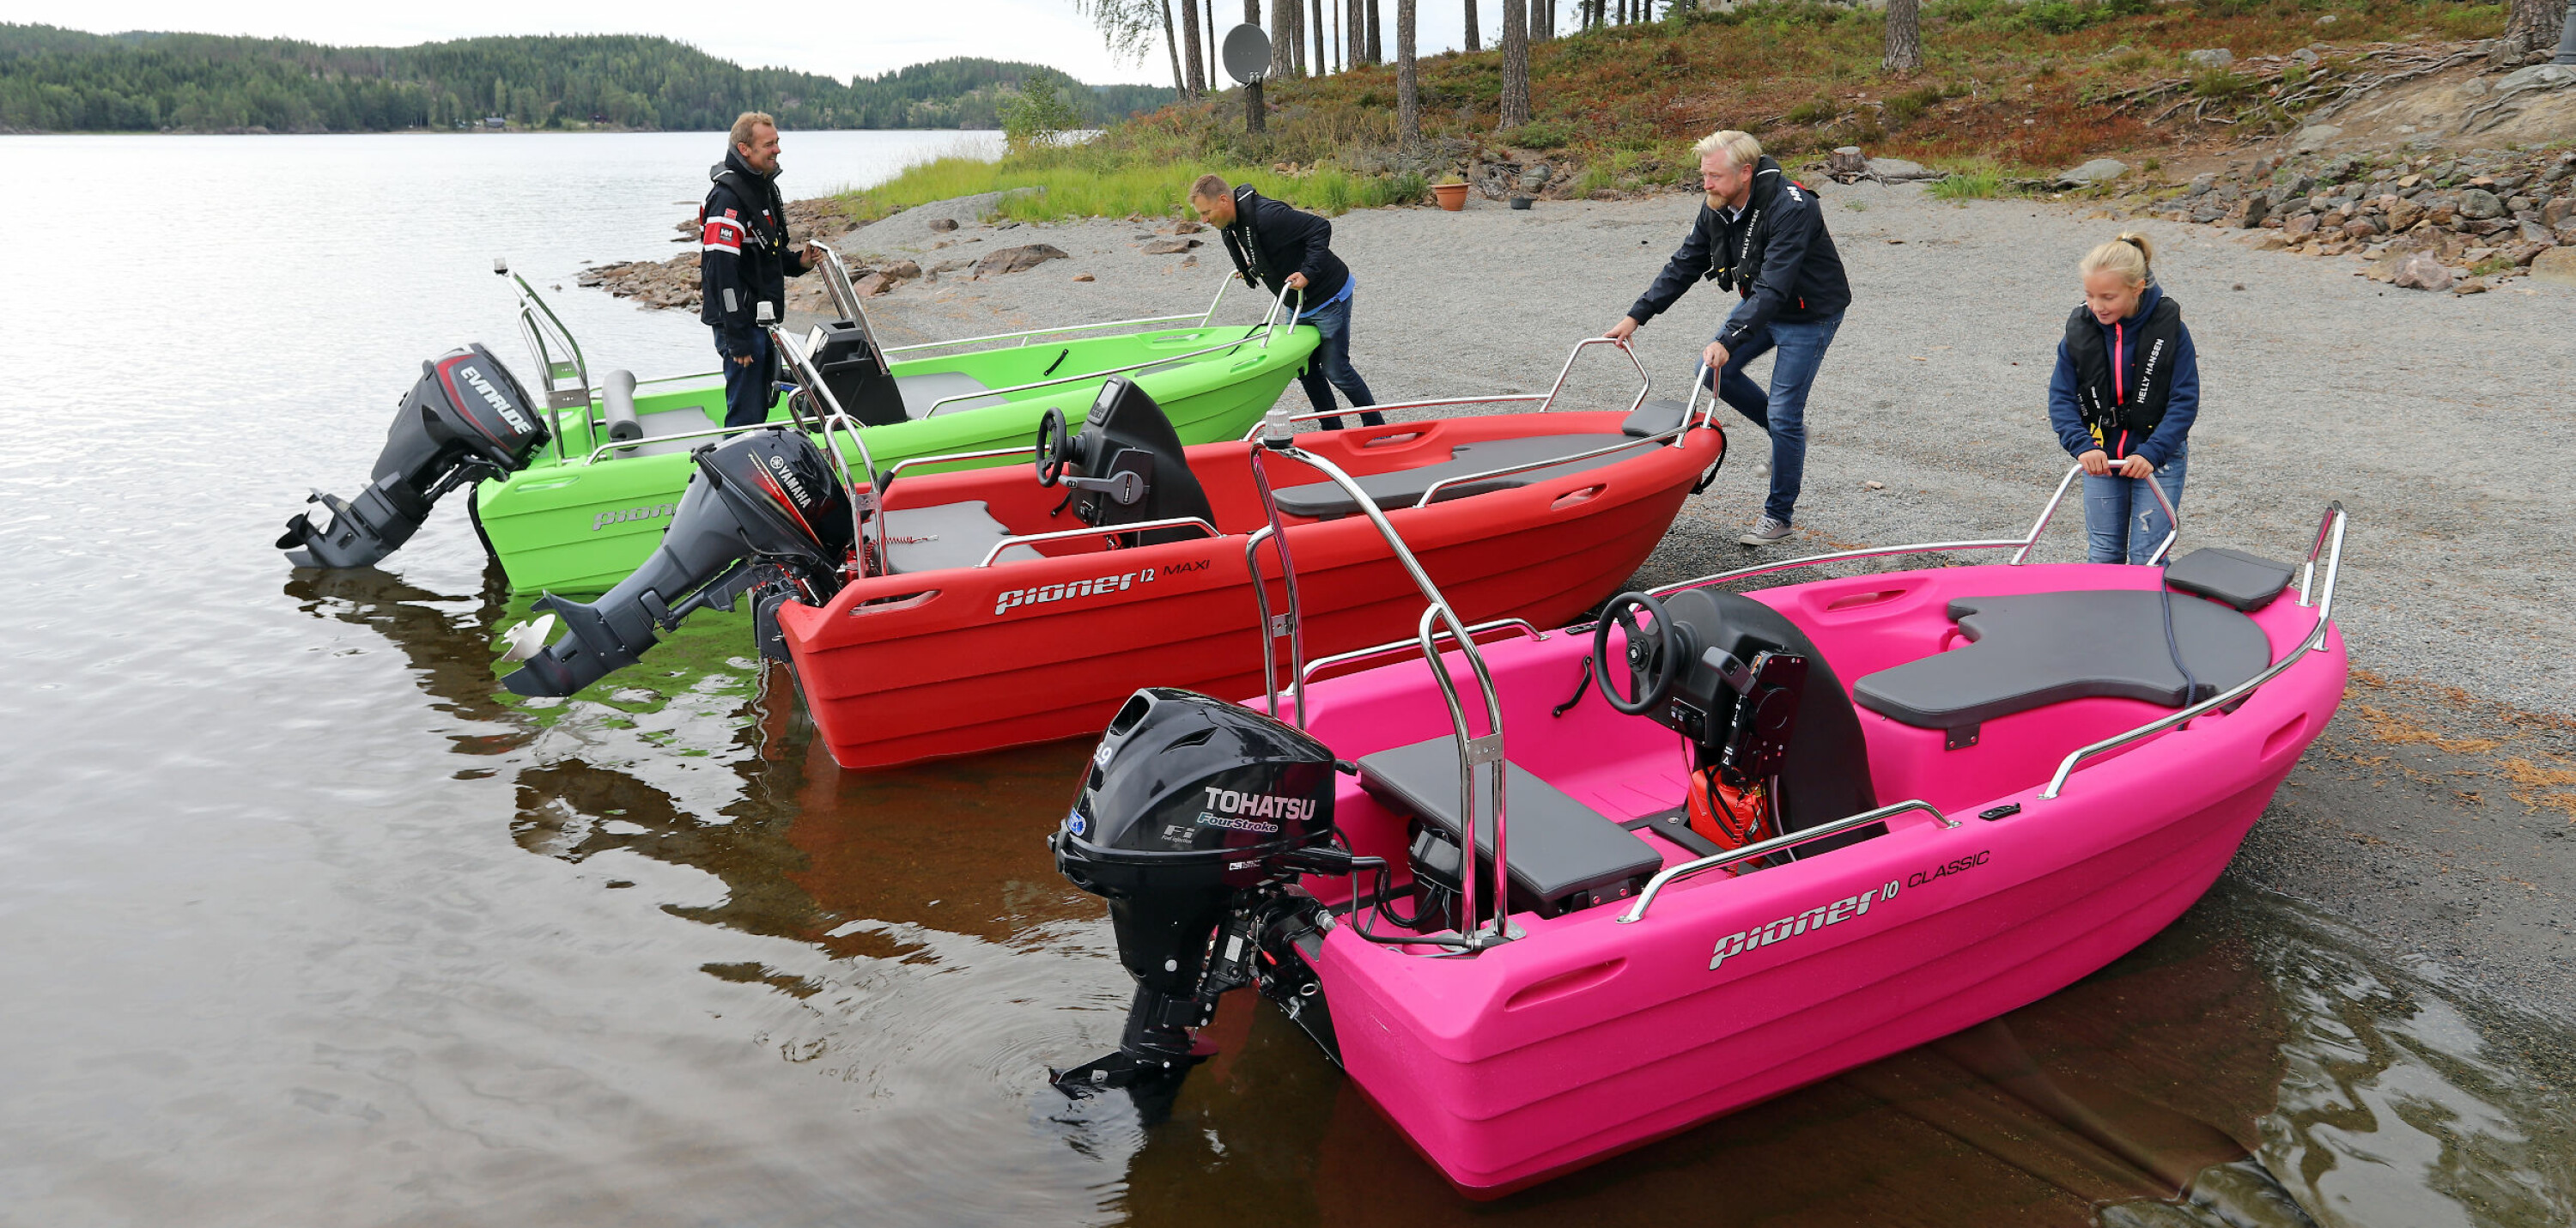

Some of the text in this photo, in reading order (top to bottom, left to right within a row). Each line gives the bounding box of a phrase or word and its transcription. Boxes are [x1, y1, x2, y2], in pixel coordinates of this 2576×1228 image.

[2136, 338, 2165, 404] HELLY HANSEN
[460, 366, 532, 435] EVINRUDE
[778, 465, 811, 508] YAMAHA
[592, 503, 676, 531] pion
[994, 559, 1211, 616] pioner 12 MAXI
[1197, 812, 1279, 833] FourStroke
[1205, 786, 1316, 821] TOHATSU
[1709, 850, 1991, 971] pioner 10 CLASSIC
